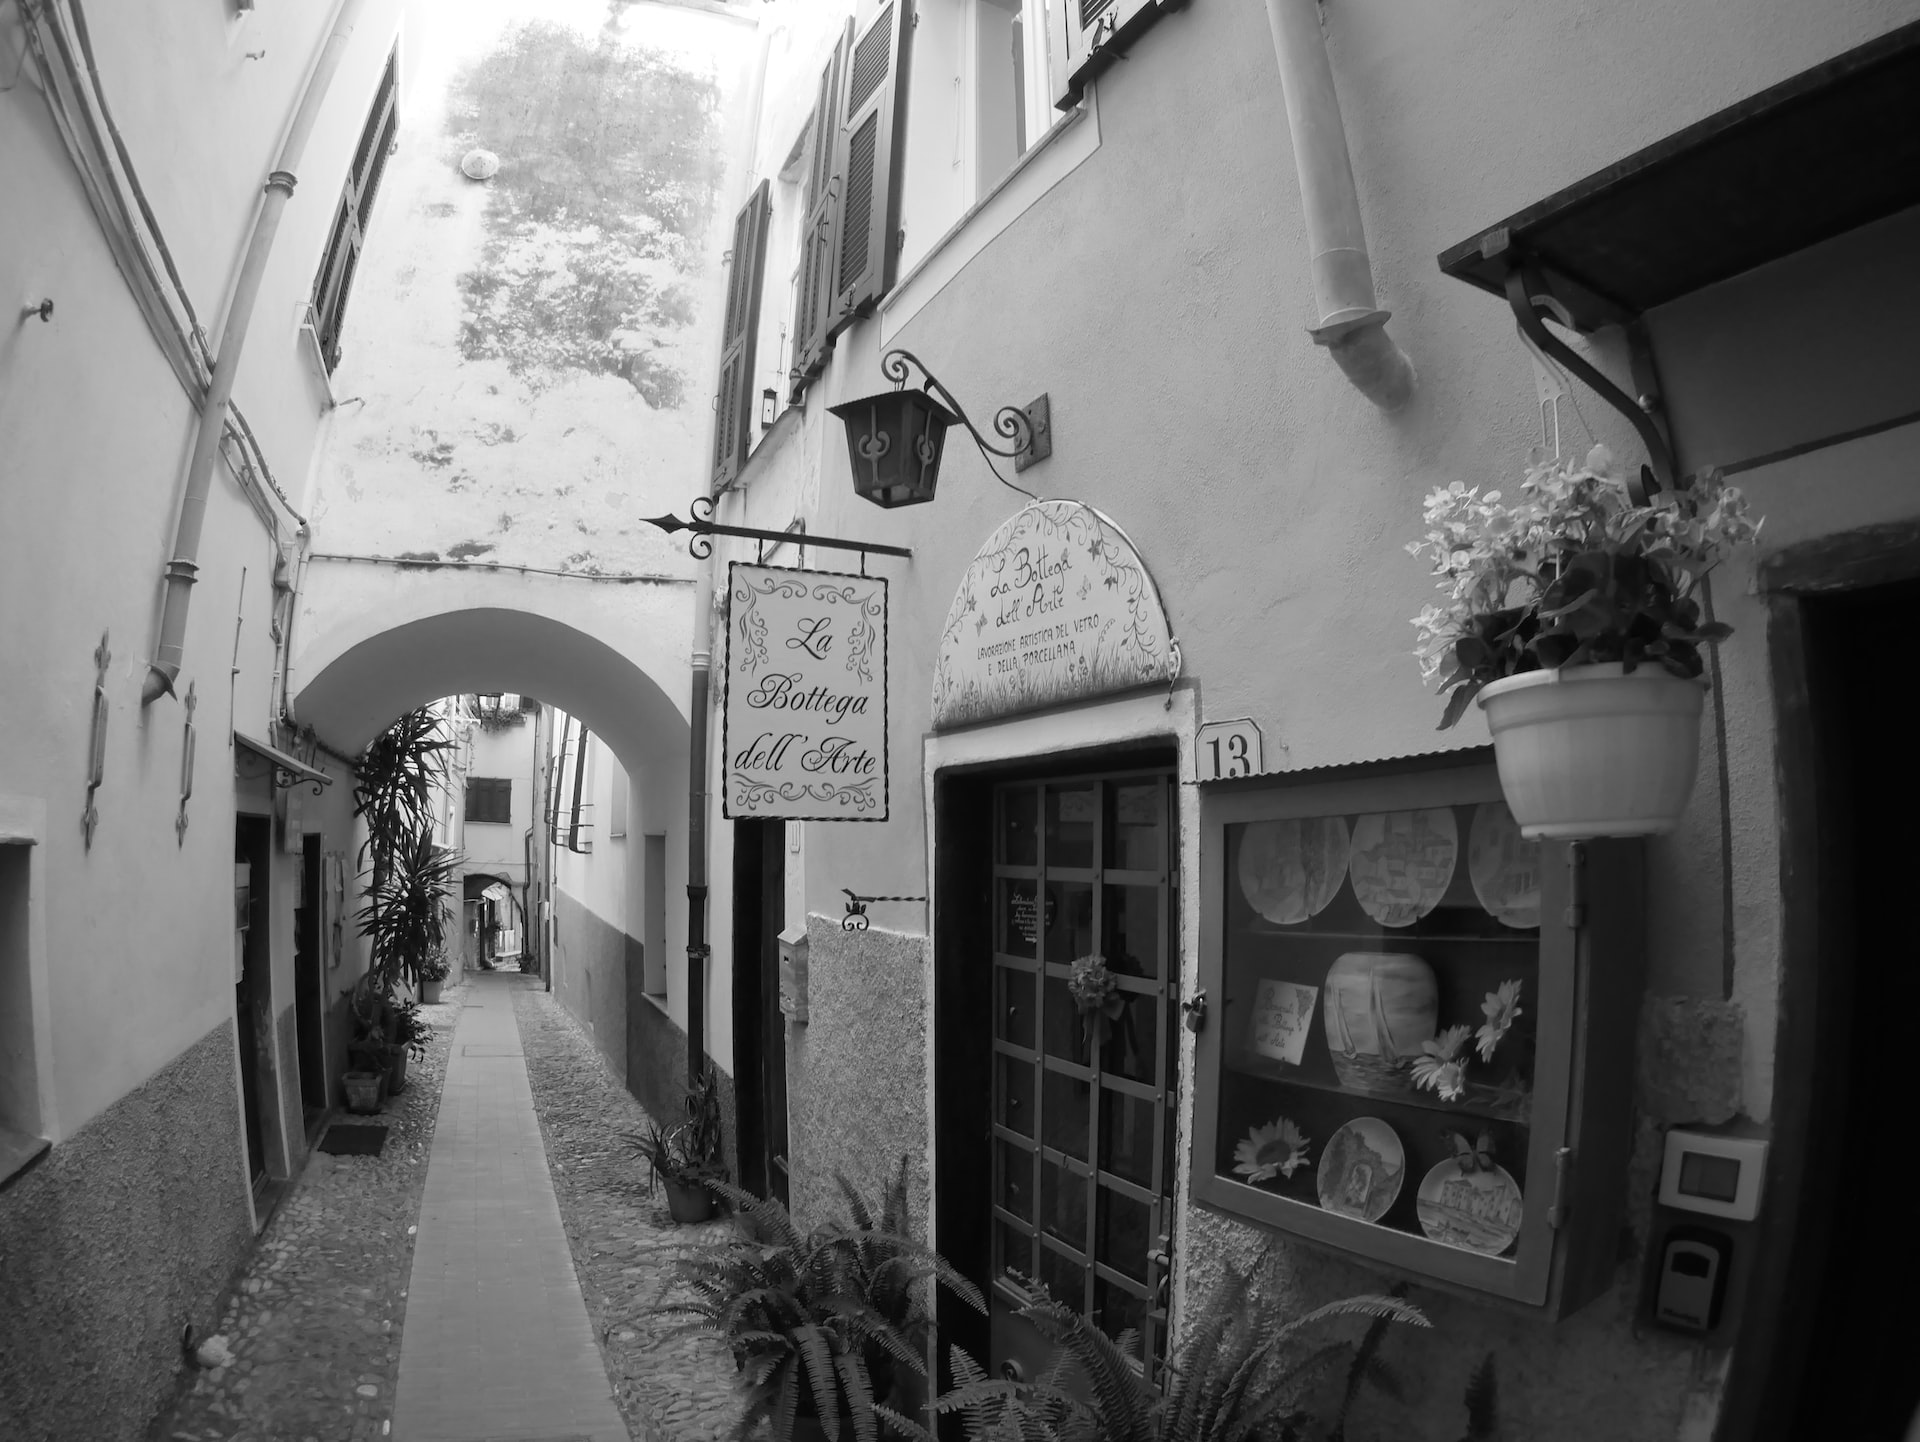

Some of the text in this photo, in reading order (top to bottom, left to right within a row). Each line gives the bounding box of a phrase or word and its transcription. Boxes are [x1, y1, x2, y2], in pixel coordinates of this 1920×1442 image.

[991, 545, 1073, 598] La Bottega
[786, 618, 832, 660] La
[977, 613, 1100, 661] LAVORAZIONE ARTISTICA DEL VETRO
[987, 639, 1076, 677] E DELLA PORCELLANA
[747, 672, 869, 725] Bottega
[1206, 735, 1250, 778] 13
